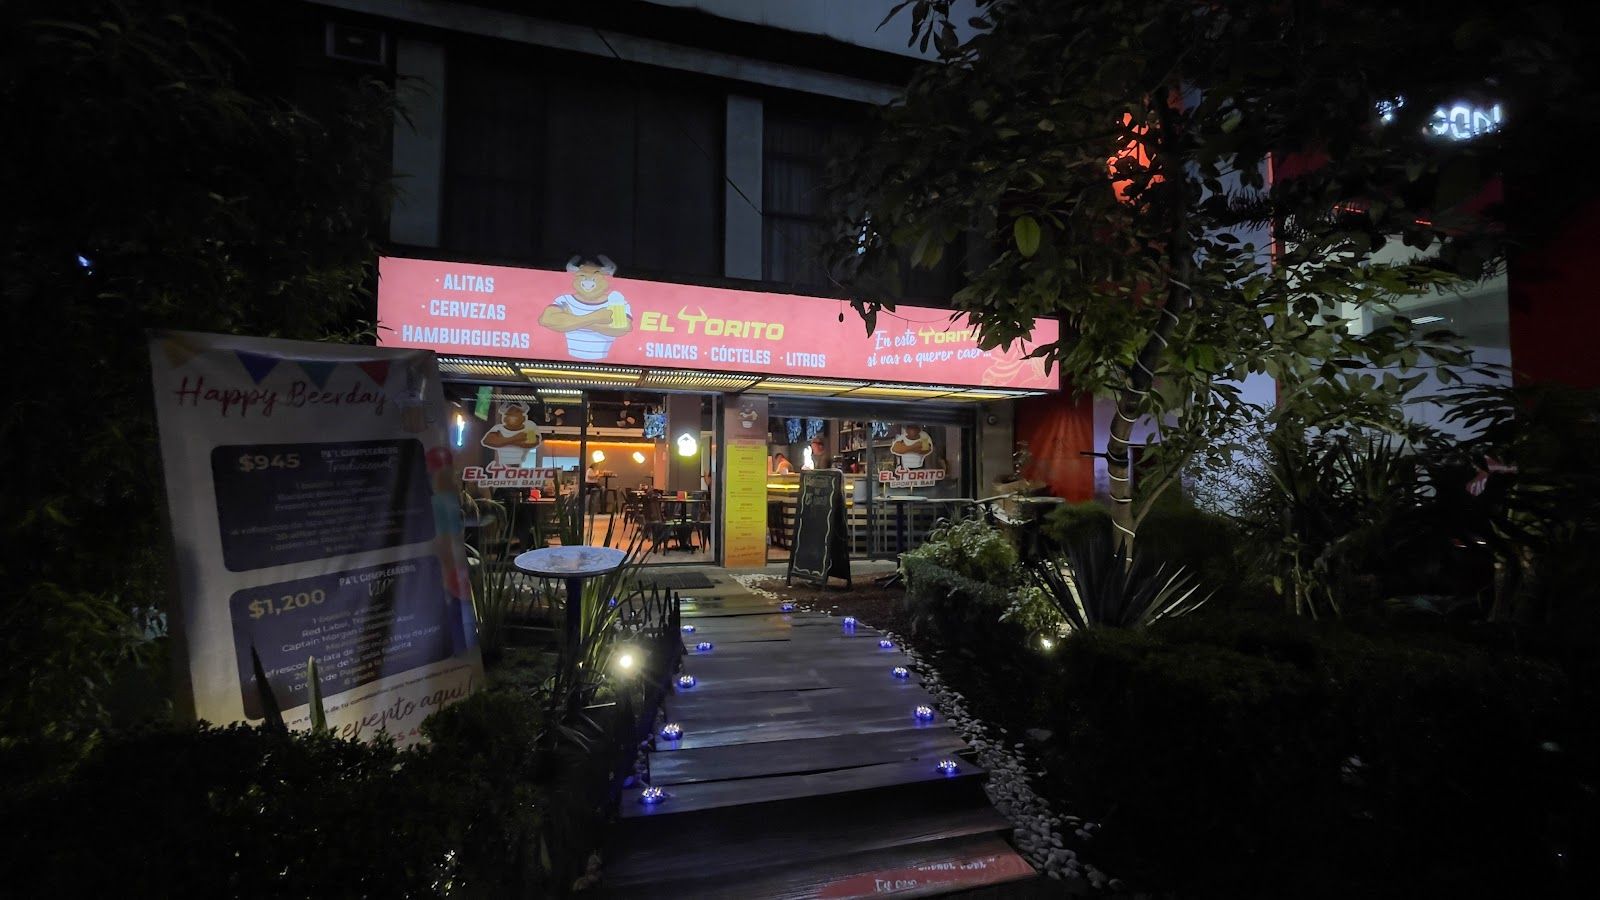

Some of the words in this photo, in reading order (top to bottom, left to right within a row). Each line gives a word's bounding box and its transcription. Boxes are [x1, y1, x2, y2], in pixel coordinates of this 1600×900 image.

[443, 274, 495, 293] ALITAS
[430, 299, 506, 321] CERVEZAS
[639, 311, 675, 333] EL
[678, 305, 785, 341] TORITO
[402, 325, 530, 349] HAMBURGUESAS
[874, 330, 892, 350] En
[894, 329, 917, 346] este
[918, 326, 983, 345] TORIT
[645, 342, 698, 360] SNACKS
[711, 345, 771, 365] CÓCTELES
[786, 351, 826, 368] LITROS
[880, 354, 900, 365] vas
[903, 353, 912, 364] a
[916, 350, 953, 370] querer
[176, 376, 278, 417] Happy
[286, 381, 387, 417] Beerday
[238, 453, 301, 472] $945
[464, 468, 486, 479] EL
[880, 471, 895, 481] EL
[896, 467, 944, 480] TORITO
[248, 588, 326, 620] $1,200
[281, 638, 320, 652] Captain
